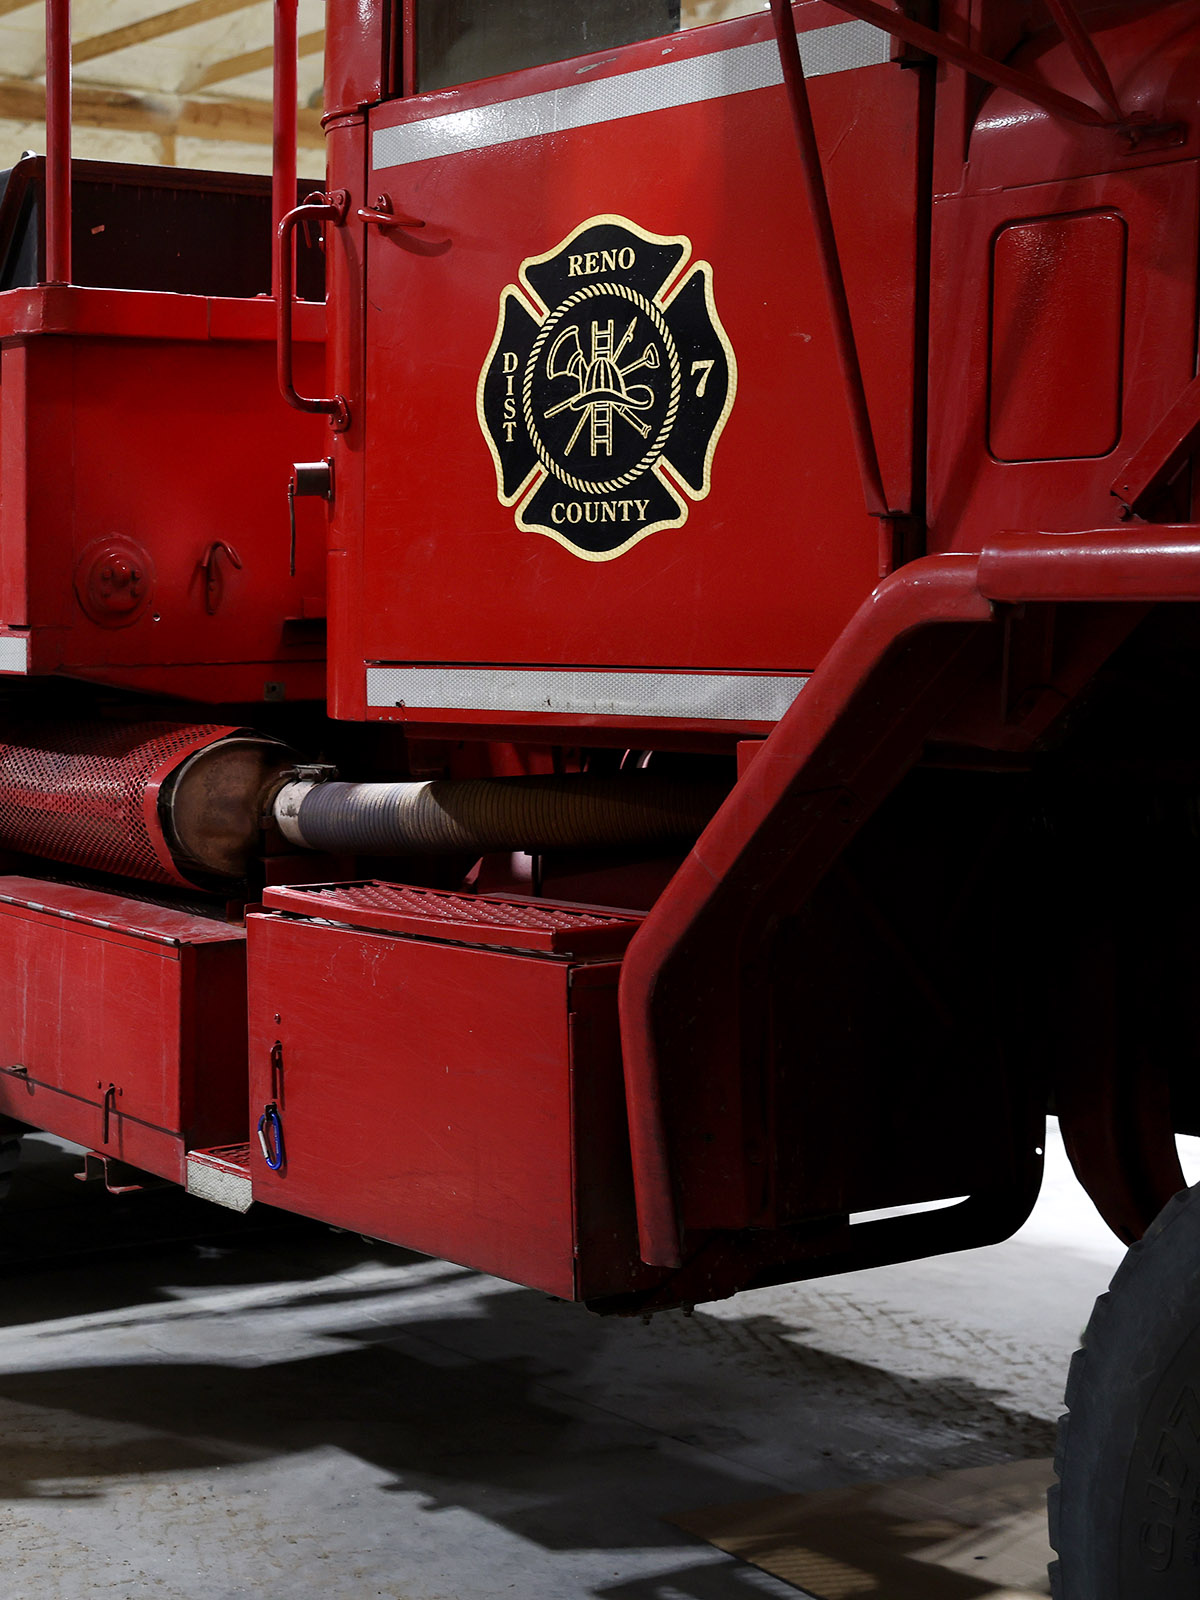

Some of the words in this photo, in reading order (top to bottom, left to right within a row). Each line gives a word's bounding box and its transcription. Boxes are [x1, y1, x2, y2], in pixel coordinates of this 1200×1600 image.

[567, 247, 636, 278] RENO
[690, 359, 716, 398] 7
[502, 352, 519, 443] DIST
[550, 499, 650, 524] COUNTY
